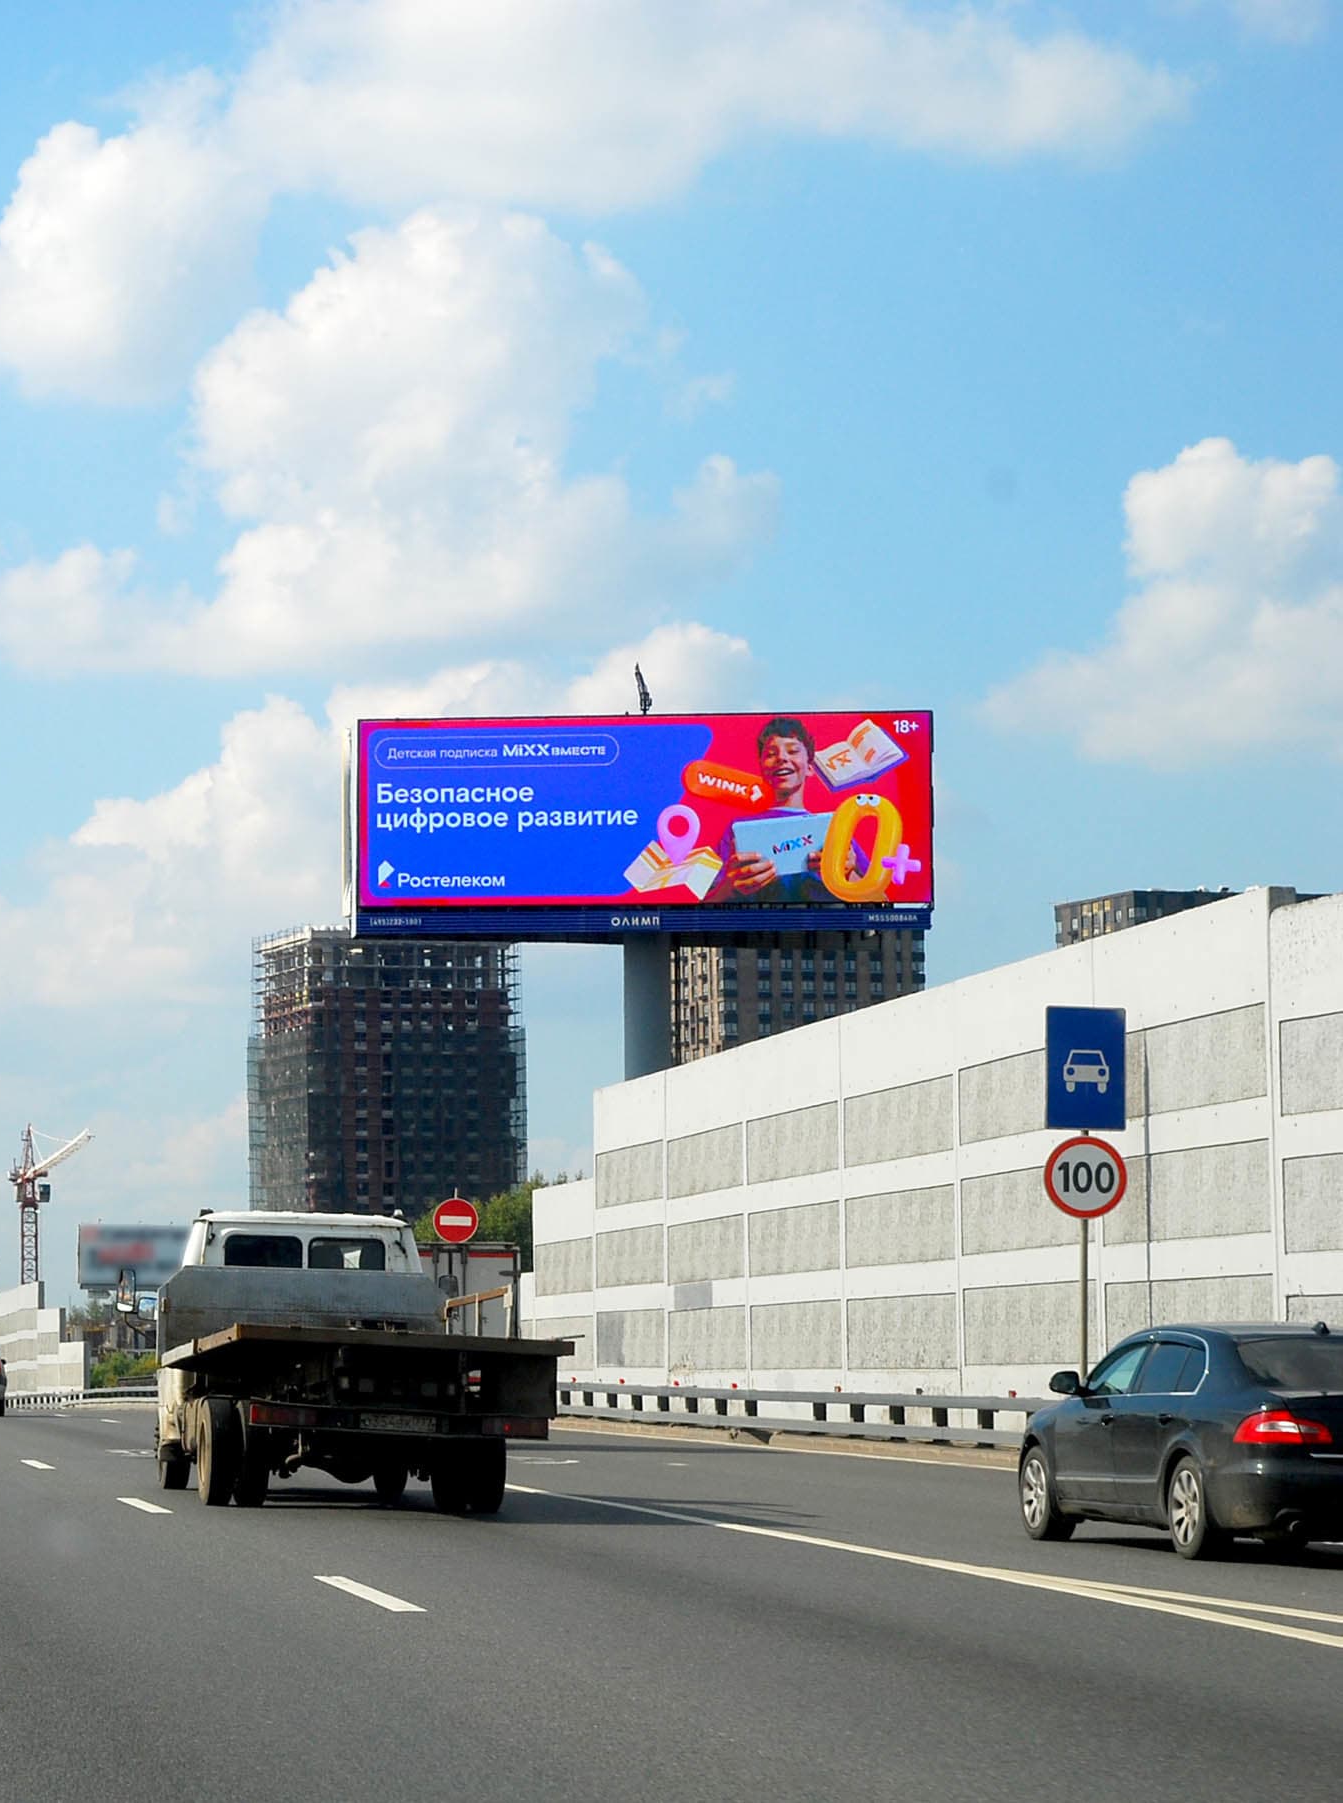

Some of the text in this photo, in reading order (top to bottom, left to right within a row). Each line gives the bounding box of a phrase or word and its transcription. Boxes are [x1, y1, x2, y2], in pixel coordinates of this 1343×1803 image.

[893, 719, 920, 733] 18+
[387, 747, 437, 760] Детская
[440, 748, 498, 760] подписка
[551, 745, 606, 756] ВМЕСТЕ
[376, 783, 535, 804] Безопасное
[697, 772, 748, 797] WINK
[376, 808, 639, 833] цифровое развитие
[397, 872, 506, 888] Ростелеком
[610, 916, 660, 927] ОЛИМП
[1058, 1161, 1115, 1194] 100
